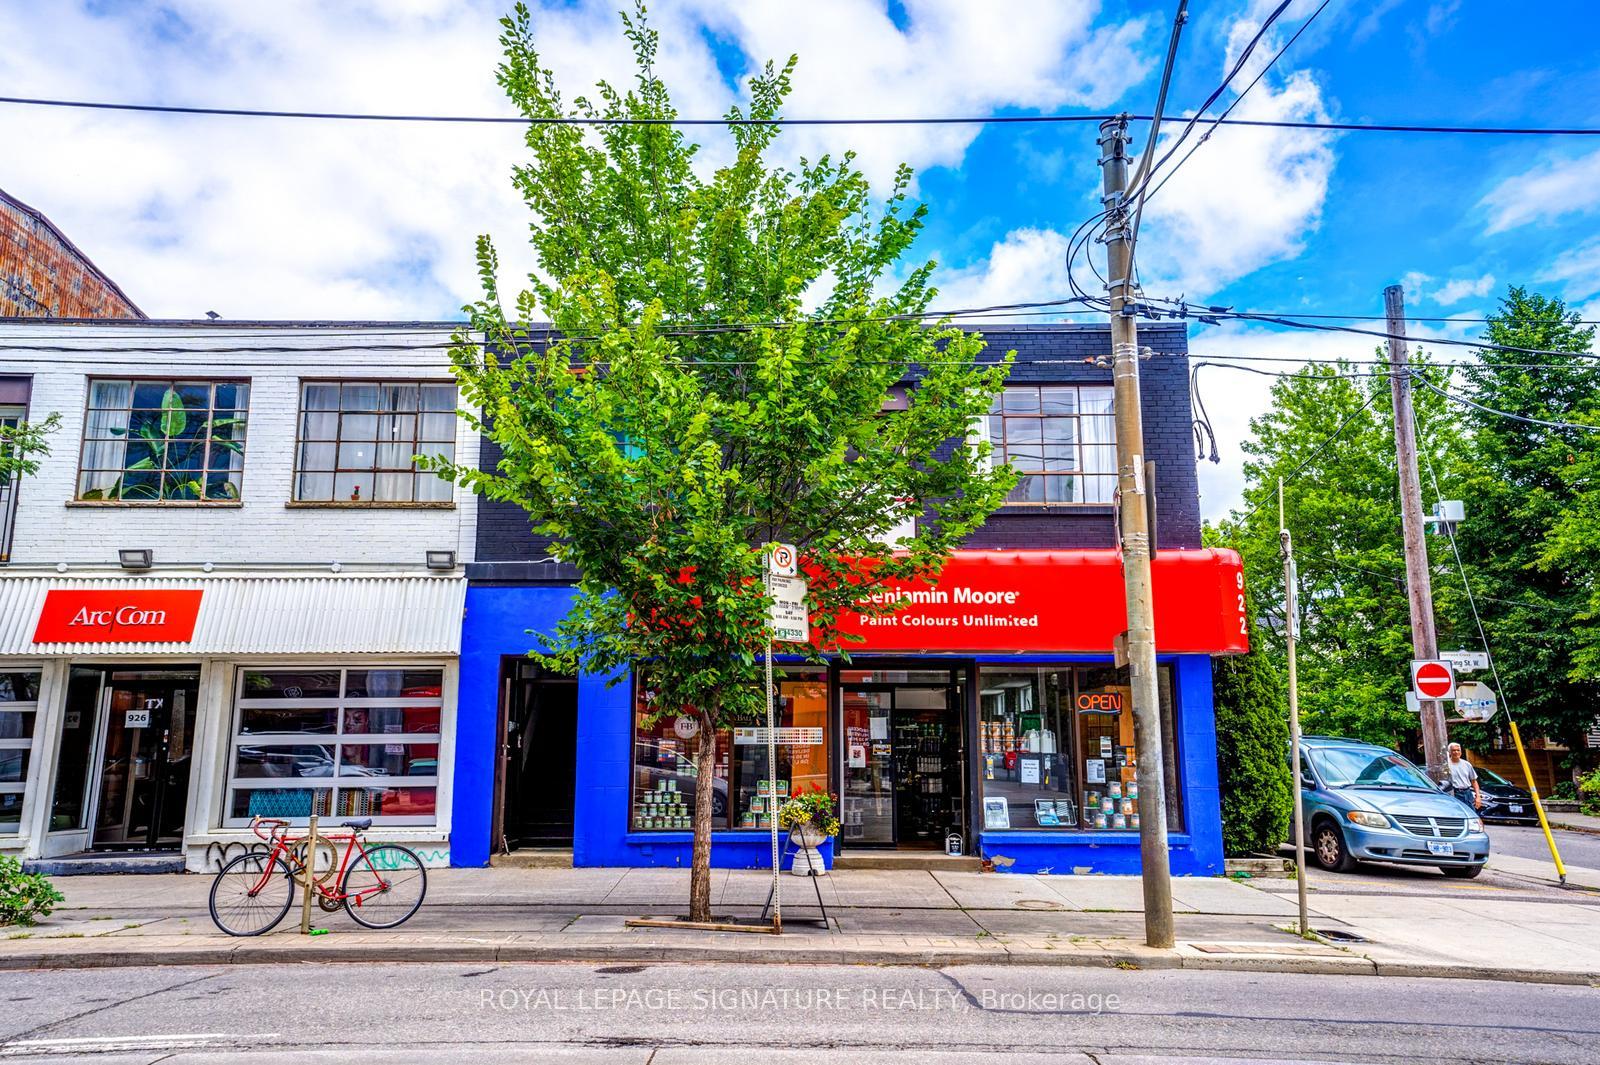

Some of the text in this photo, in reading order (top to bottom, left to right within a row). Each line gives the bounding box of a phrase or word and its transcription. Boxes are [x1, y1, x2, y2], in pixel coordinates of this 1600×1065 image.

[1236, 571, 1247, 635] 922
[860, 615, 1038, 627] Paint Colours Unlimited
[1078, 694, 1121, 710] OPEN
[128, 714, 146, 722] 926
